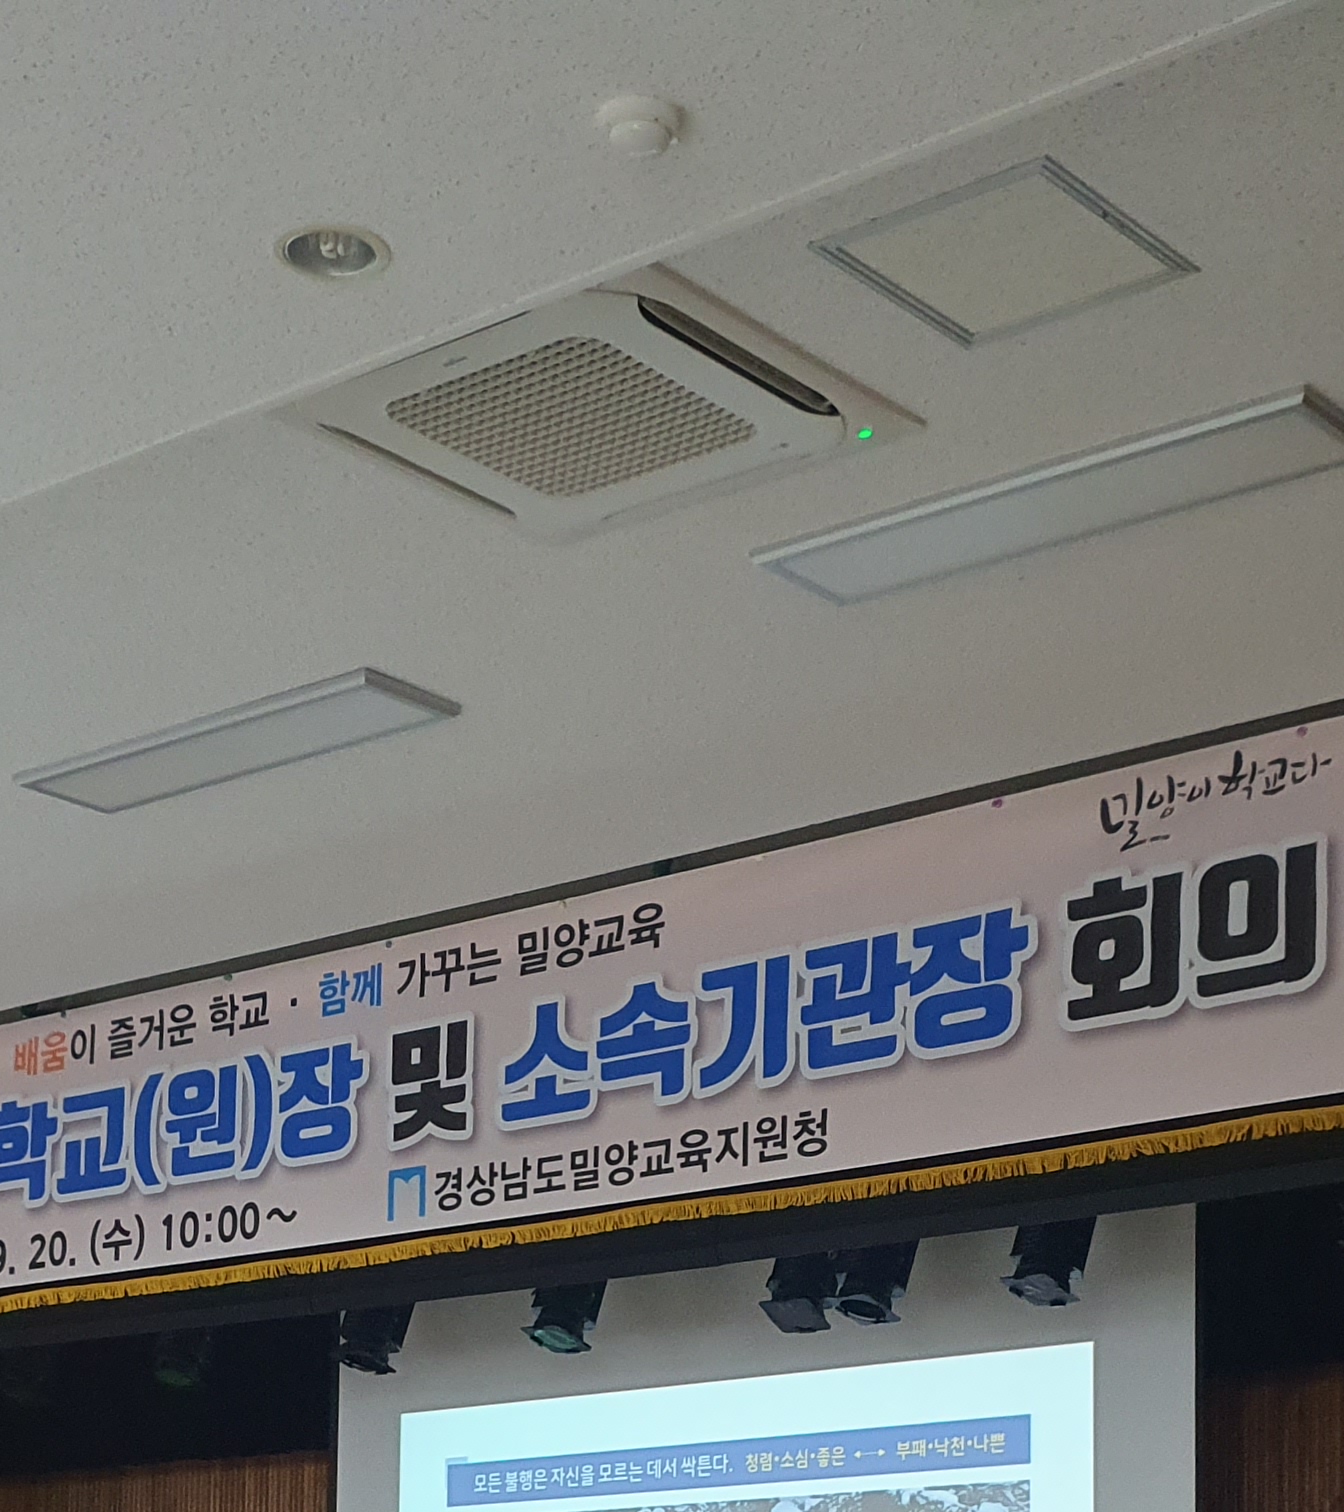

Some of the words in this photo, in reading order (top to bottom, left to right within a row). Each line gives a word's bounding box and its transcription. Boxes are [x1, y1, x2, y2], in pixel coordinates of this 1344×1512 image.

[14, 1023, 97, 1076] 배움이
[107, 1004, 194, 1058] 즐거운
[208, 991, 269, 1037] 학교
[318, 962, 383, 1019] 함께
[397, 941, 502, 1000] 가꾸는
[517, 902, 665, 977] 밀양교육
[392, 1018, 469, 1143] 및
[502, 907, 1029, 1122] 소속기관장
[1067, 841, 1318, 1021] 회의
[434, 1107, 830, 1212] 경상남도밀양교육지원청
[28, 1230, 76, 1271] 20.
[90, 1213, 145, 1267] (수)
[473, 1473, 503, 1494] 모든
[505, 1468, 548, 1493] 불행은
[550, 1464, 596, 1488] 자신을
[597, 1461, 644, 1485] 모르는
[646, 1457, 678, 1479] 데서
[680, 1453, 734, 1478] 싹튼다.
